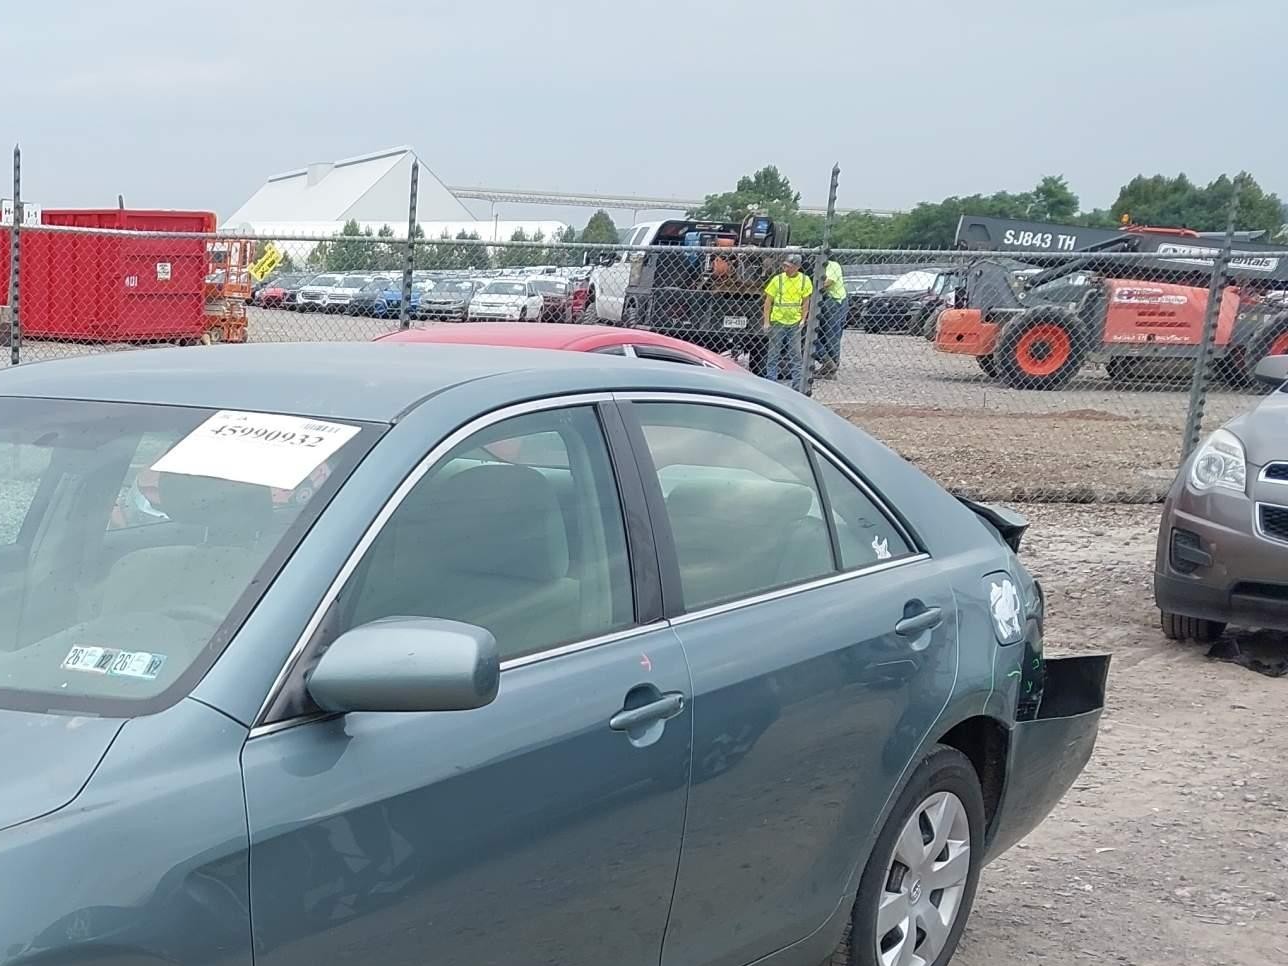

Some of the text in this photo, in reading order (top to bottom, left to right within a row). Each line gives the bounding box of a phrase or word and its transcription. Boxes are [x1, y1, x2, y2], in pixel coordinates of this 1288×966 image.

[1004, 229, 1077, 251] SJ843 TH
[125, 276, 138, 287] 401
[211, 424, 324, 448] 45990932
